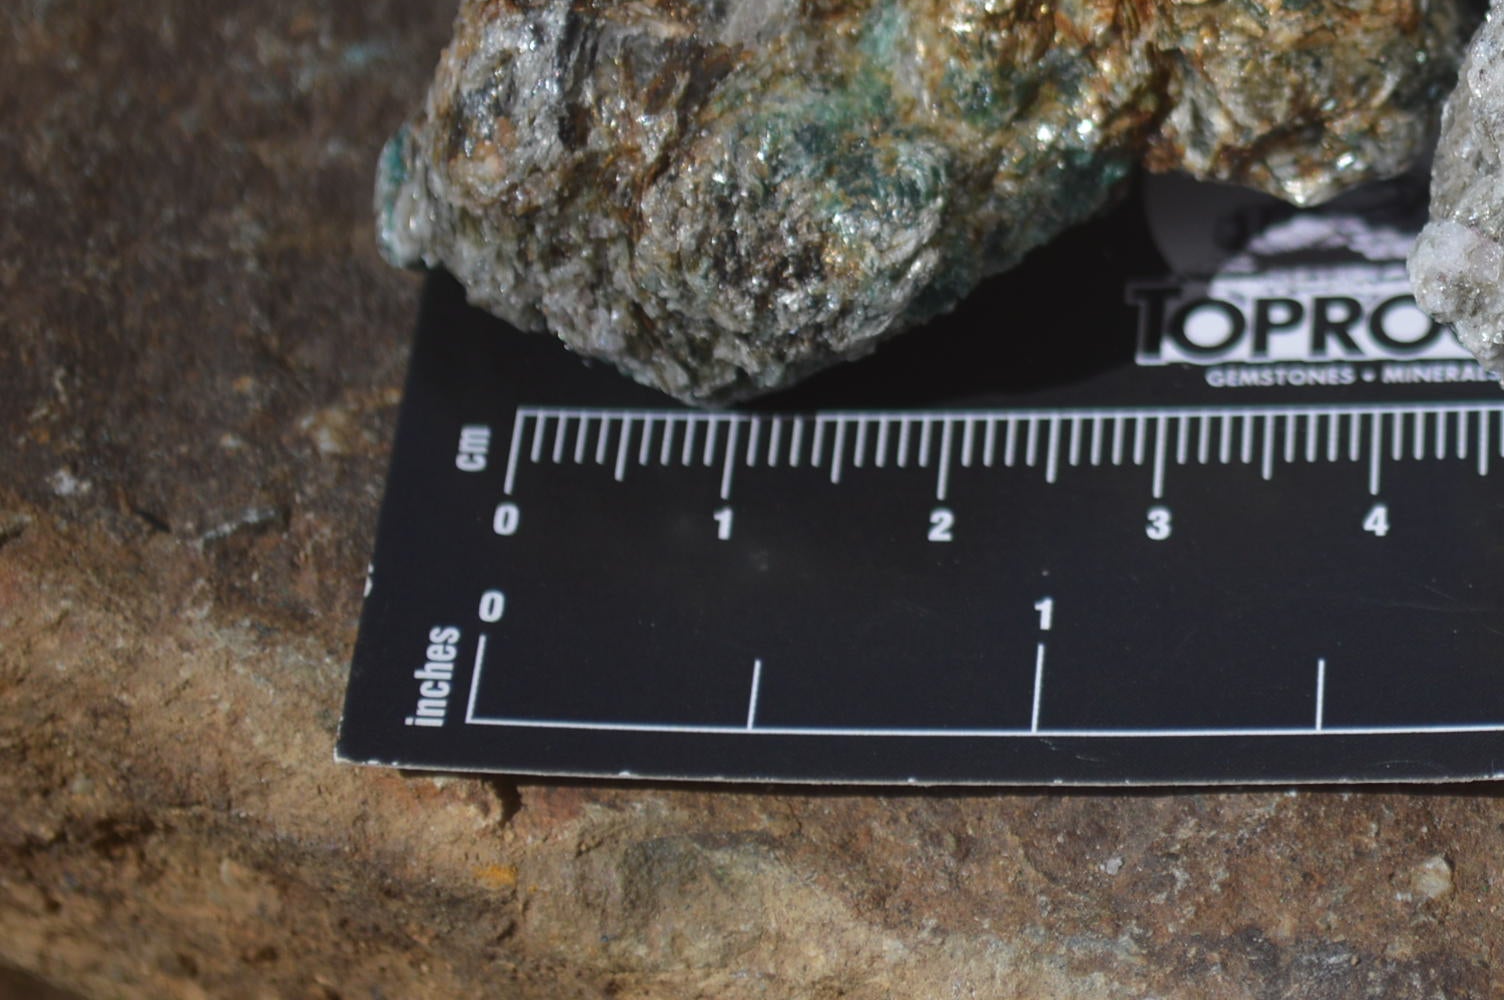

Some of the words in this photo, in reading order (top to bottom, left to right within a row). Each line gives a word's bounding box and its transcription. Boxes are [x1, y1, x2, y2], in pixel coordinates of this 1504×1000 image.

[1127, 286, 1445, 362] TOPRO
[1205, 365, 1356, 388] GEMSTONES
[455, 426, 491, 473] cm
[493, 503, 519, 537] 0
[713, 508, 733, 541] 1
[927, 509, 955, 543] 2
[1145, 507, 1172, 542] 3
[1363, 504, 1390, 538] 4
[478, 590, 505, 624] 0
[1034, 597, 1053, 632] 1
[403, 625, 461, 728] inches
